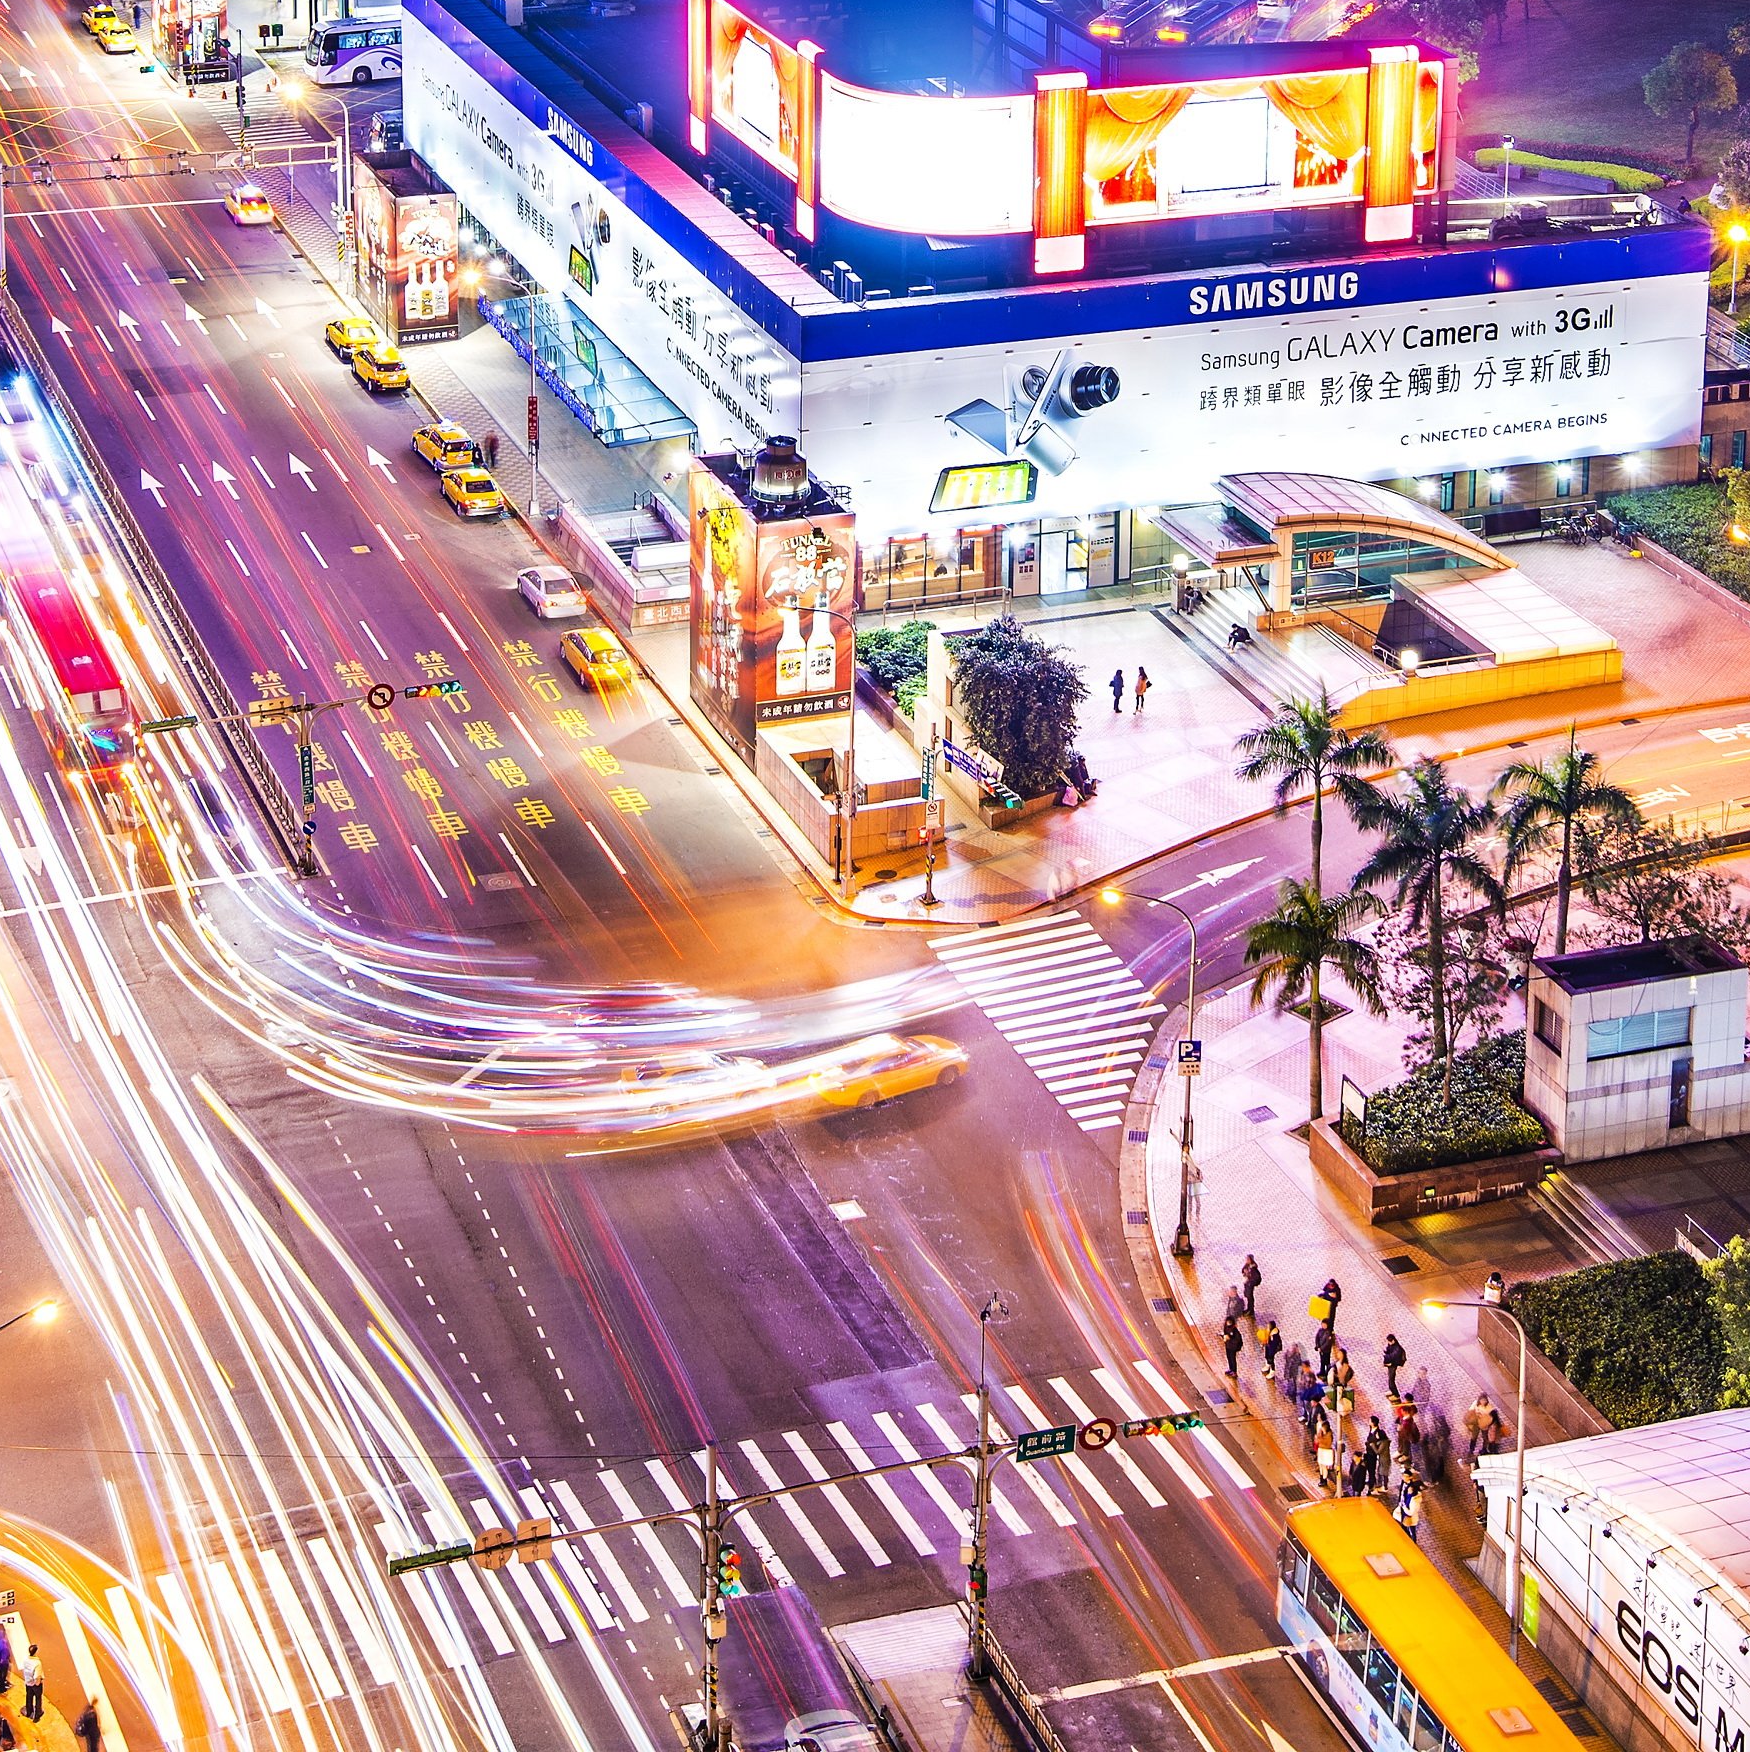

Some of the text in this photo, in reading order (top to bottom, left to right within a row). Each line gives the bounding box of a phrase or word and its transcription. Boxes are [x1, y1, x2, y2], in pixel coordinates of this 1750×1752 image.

[445, 84, 480, 137] GALAXY
[481, 116, 514, 170] Camera
[547, 106, 594, 167] SAMSUNG
[1188, 271, 1359, 316] SAMSUNG
[1201, 308, 1591, 372] Samsung GALAXY Camera with 3G
[666, 337, 711, 390] CNNECTED
[712, 380, 743, 424] CAMERA
[1199, 348, 1612, 412] 跨界類單眼 影像全觸動 分享新感動
[1493, 420, 1553, 436] CAMERA
[1557, 413, 1608, 430] BEGINS
[781, 534, 833, 551] TUNNL
[795, 544, 818, 562] 88
[1312, 550, 1335, 564] K12
[501, 639, 652, 818] 禁行機慢車
[762, 698, 834, 717] 未成年請勿飲酒
[1026, 1432, 1067, 1447] 館前路
[1618, 1599, 1700, 1727] EOS
[1715, 1706, 1745, 1752] M
